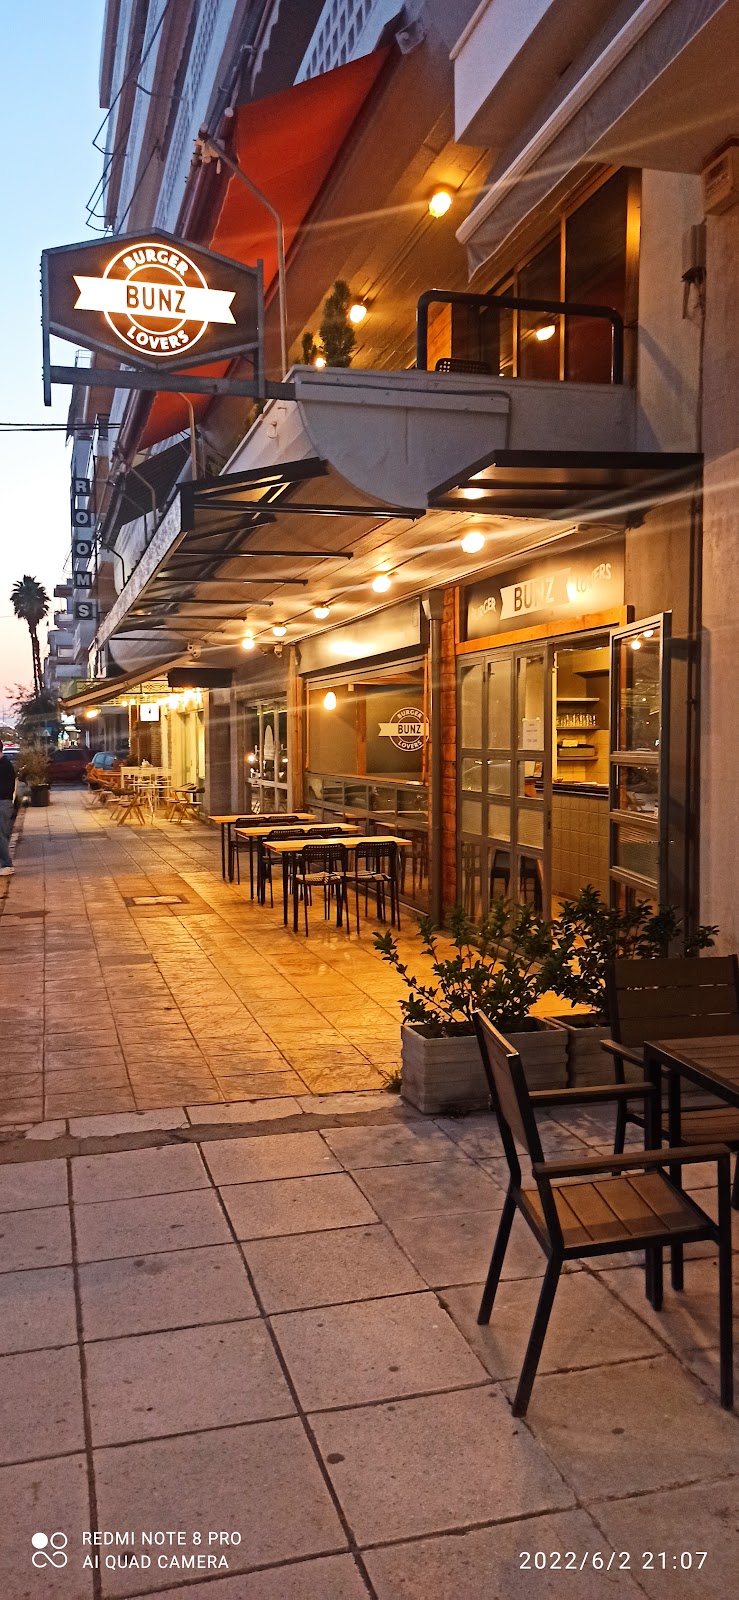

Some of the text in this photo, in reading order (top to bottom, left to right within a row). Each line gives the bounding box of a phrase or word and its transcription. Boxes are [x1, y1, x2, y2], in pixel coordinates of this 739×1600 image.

[123, 249, 189, 277] BURGER
[126, 285, 186, 314] BUNZ
[126, 325, 189, 350] LOVERS
[75, 482, 90, 618] ROOMS
[397, 710, 423, 719] BURGER
[398, 724, 421, 734] BUNZ
[398, 740, 423, 749] LOVERS
